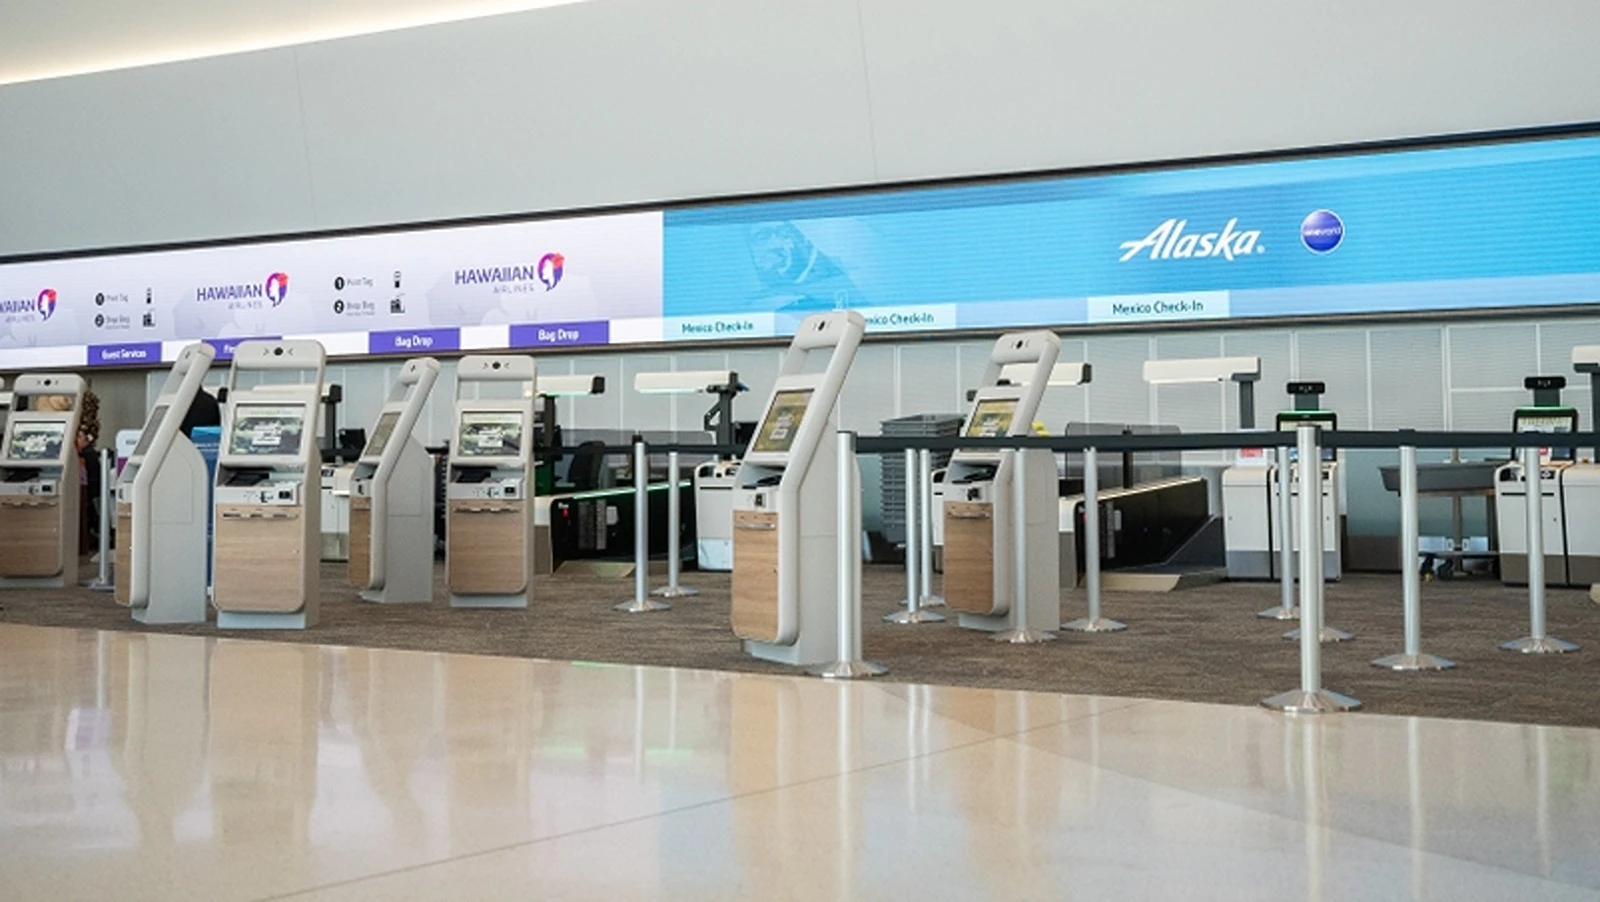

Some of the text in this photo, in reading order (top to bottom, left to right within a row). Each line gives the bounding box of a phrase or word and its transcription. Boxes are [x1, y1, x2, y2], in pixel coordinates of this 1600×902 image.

[1119, 217, 1262, 261] Alaska
[454, 265, 534, 285] HAWAIIAN
[1112, 299, 1204, 315] Mexico Check-In
[538, 328, 579, 342] Bag Drop
